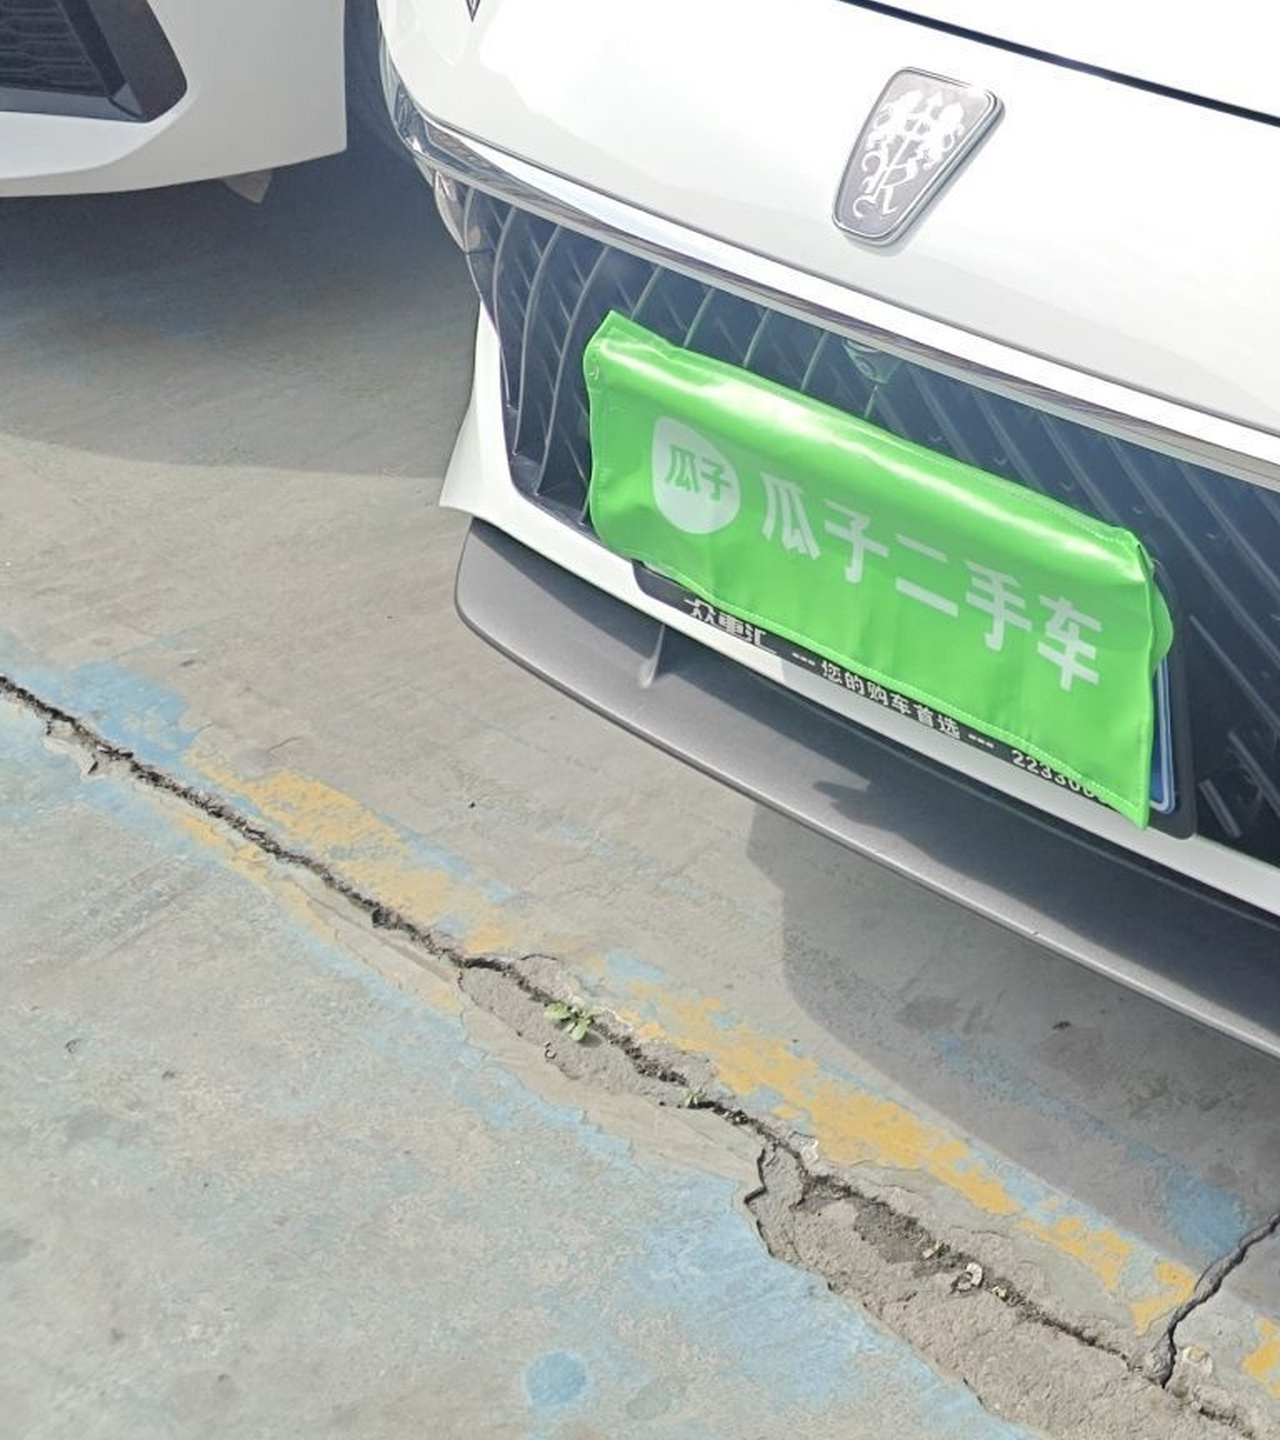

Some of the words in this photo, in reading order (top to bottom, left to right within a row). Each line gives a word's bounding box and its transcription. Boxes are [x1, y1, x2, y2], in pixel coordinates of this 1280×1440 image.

[665, 443, 731, 502] 瓜子
[760, 471, 1102, 692] 瓜子二手车
